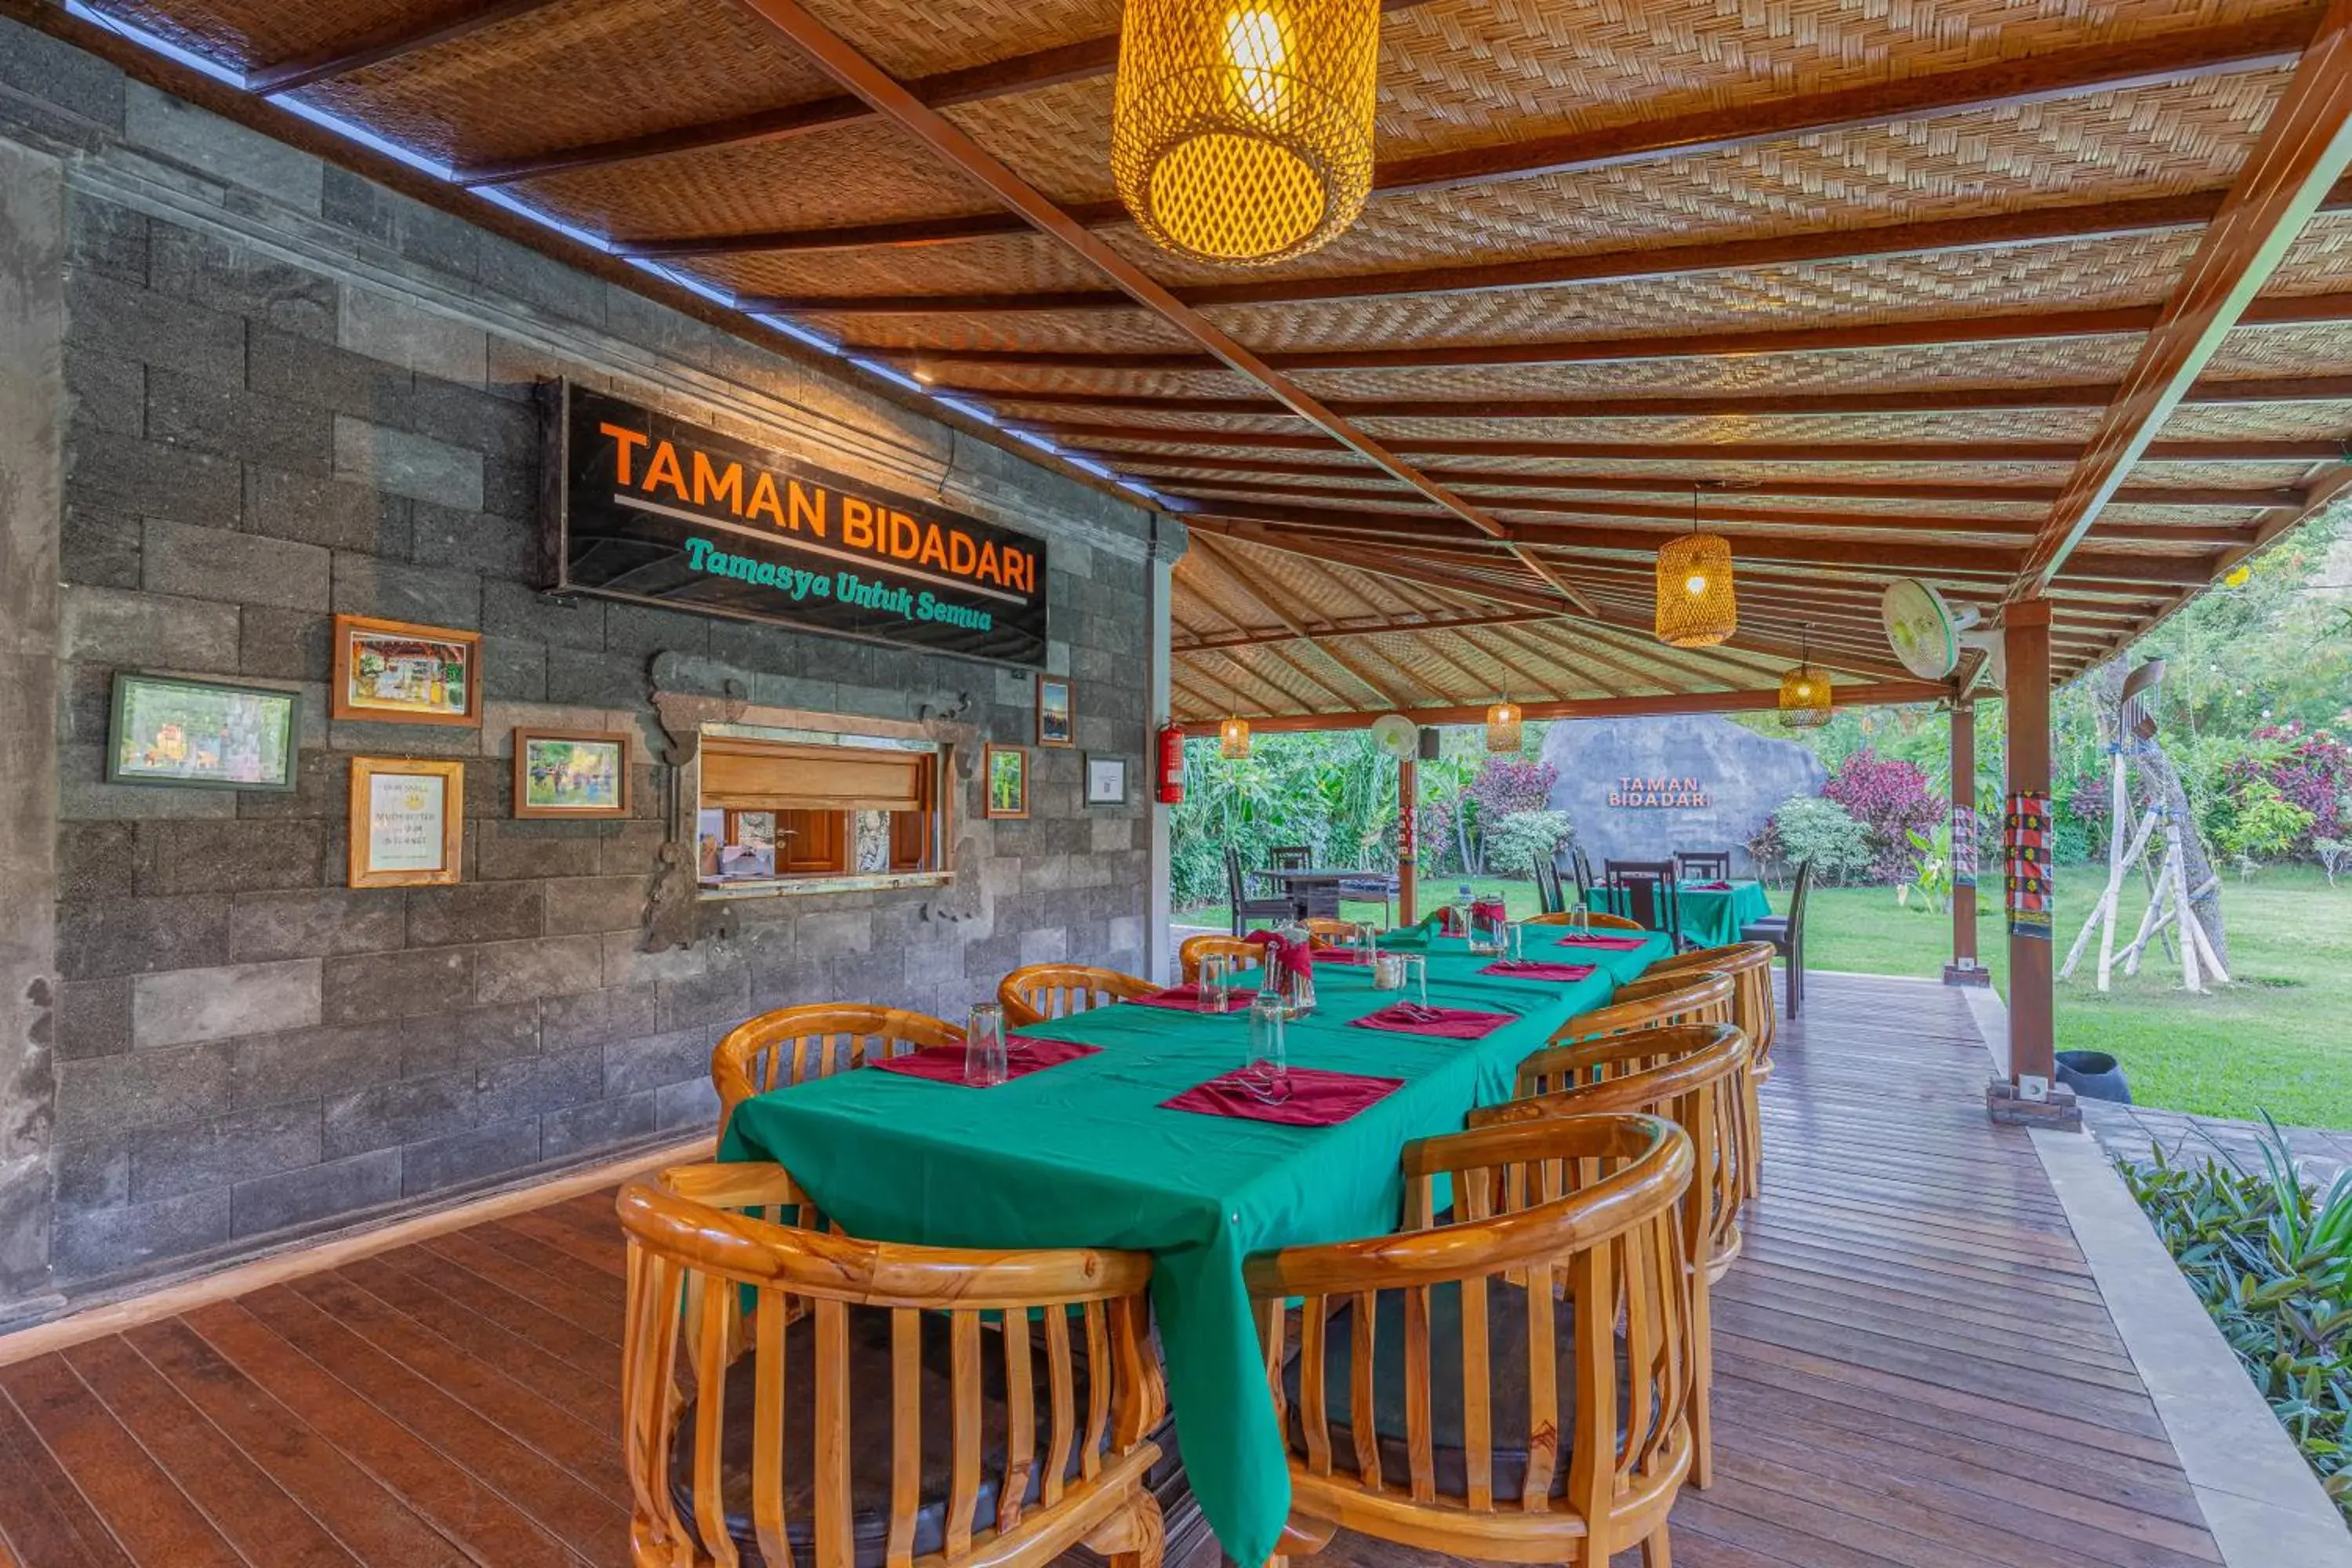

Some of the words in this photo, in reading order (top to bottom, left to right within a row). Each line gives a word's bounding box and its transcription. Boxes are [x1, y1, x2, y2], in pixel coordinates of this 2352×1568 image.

[601, 423, 826, 538] TAMAN
[843, 497, 1034, 591] BIDADARI
[684, 537, 831, 601] Tamasya
[837, 572, 914, 620] Untuk
[916, 590, 992, 631] Semua
[1610, 792, 1713, 807] BIDADARI
[1619, 777, 1698, 791] TAMAN
